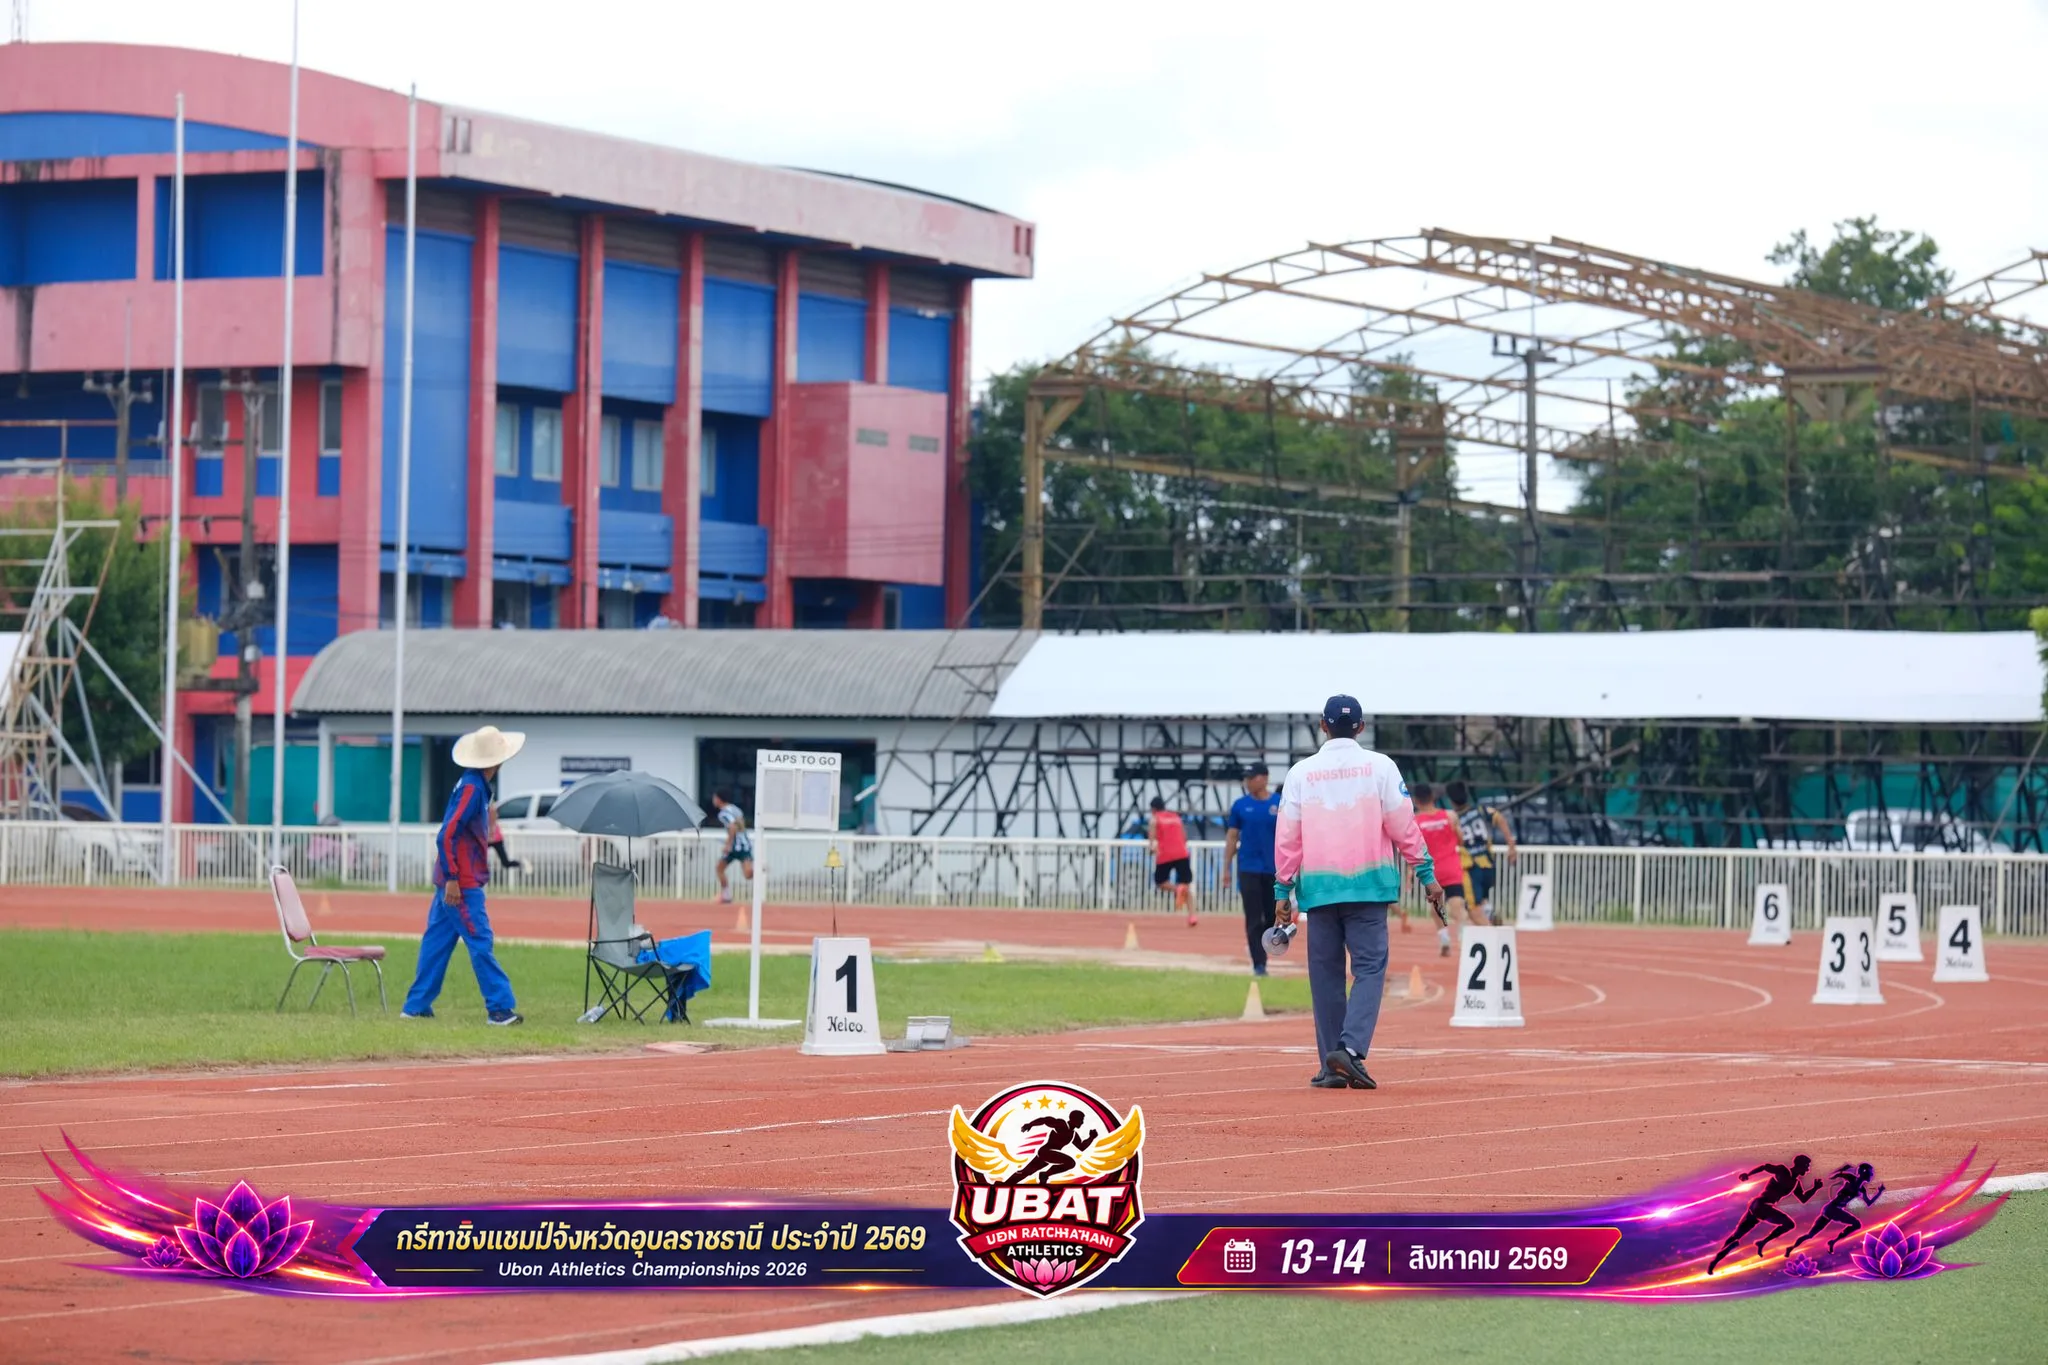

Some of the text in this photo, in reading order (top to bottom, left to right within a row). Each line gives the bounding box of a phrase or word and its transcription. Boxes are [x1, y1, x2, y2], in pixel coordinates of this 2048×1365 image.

[767, 754, 837, 766] LAPS TO GO
[1528, 884, 1543, 911] 7
[1763, 893, 1780, 922] 6
[1887, 905, 1907, 936] 5
[1948, 919, 1972, 955] 4
[1467, 943, 1488, 991] 2
[1501, 943, 1513, 991] 2
[1829, 932, 1846, 973] 3
[1859, 931, 1871, 972] 3
[835, 955, 857, 1013] 1
